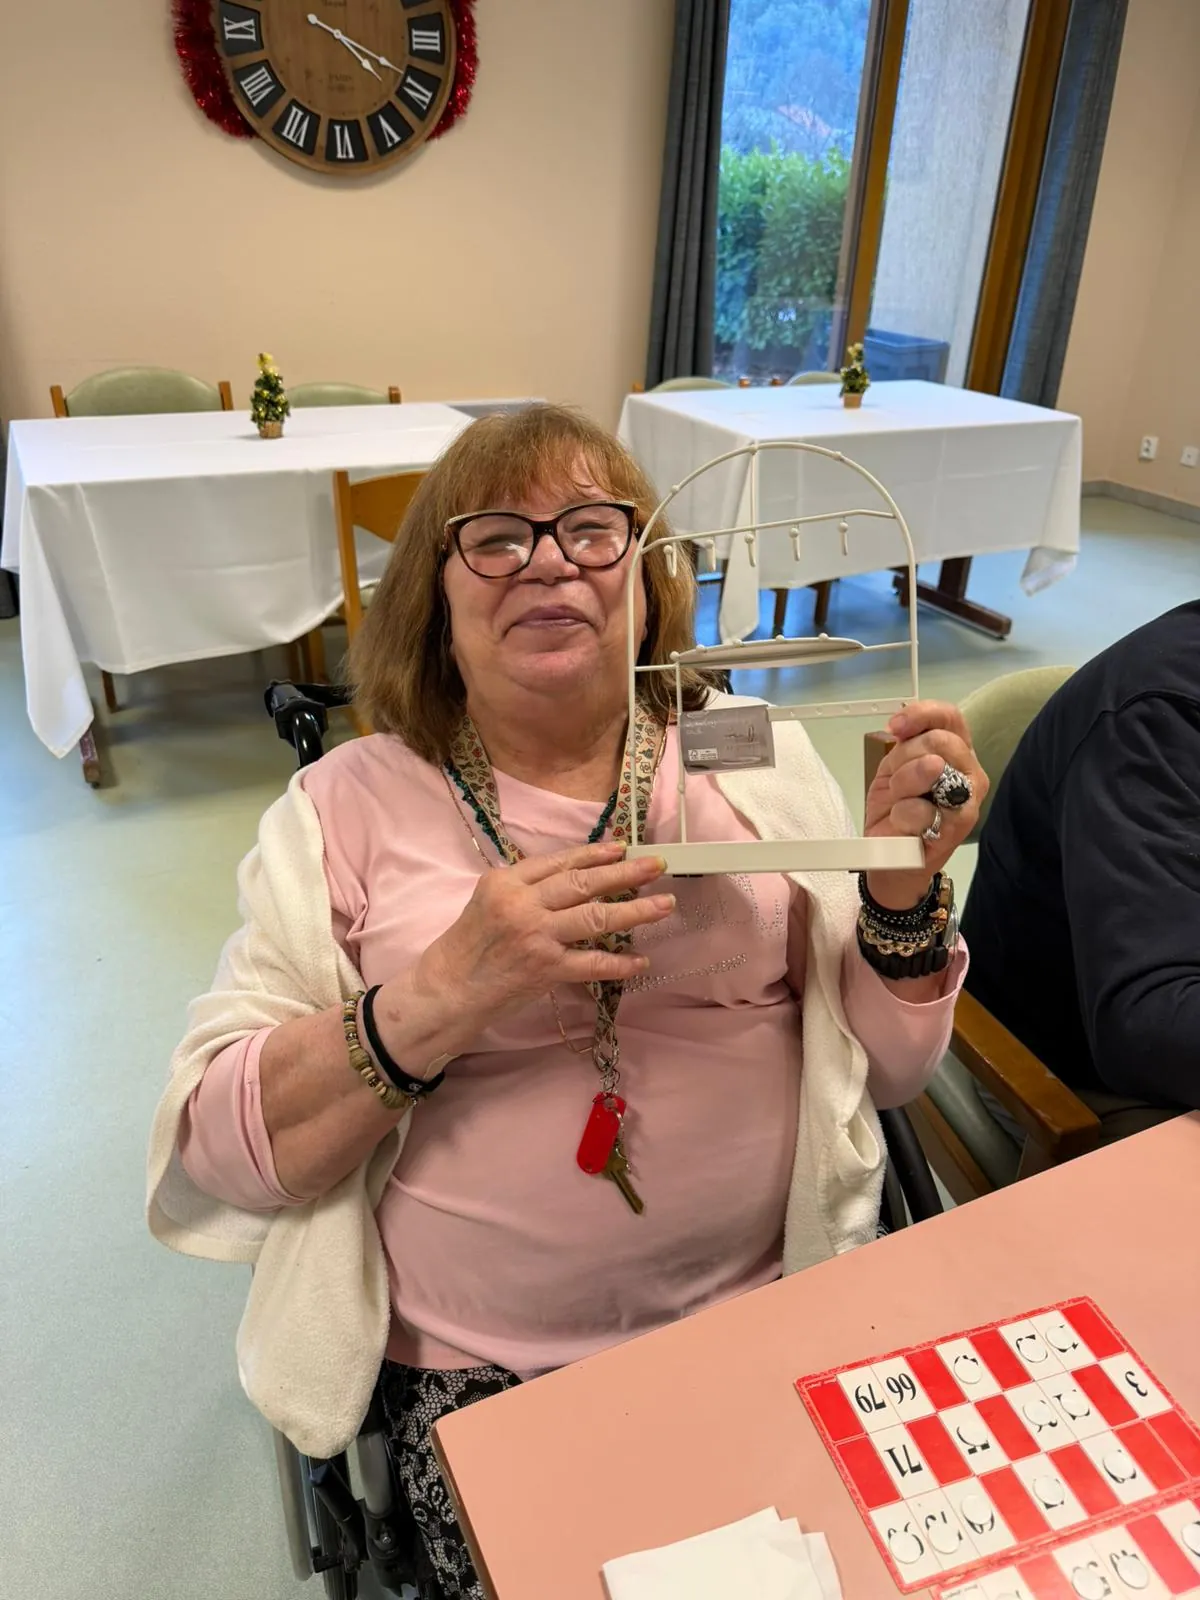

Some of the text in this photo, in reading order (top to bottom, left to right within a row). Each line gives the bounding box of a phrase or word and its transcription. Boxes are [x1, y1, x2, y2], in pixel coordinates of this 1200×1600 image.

[223, 17, 256, 41] IX
[412, 29, 441, 52] III
[240, 66, 275, 107] VIII
[403, 76, 433, 110] IV
[281, 106, 310, 148] VII
[334, 125, 355, 159] VI
[378, 114, 401, 147] V
[855, 1383, 887, 1413] 79
[1125, 1371, 1148, 1397] 3
[884, 1444, 923, 1478] 71
